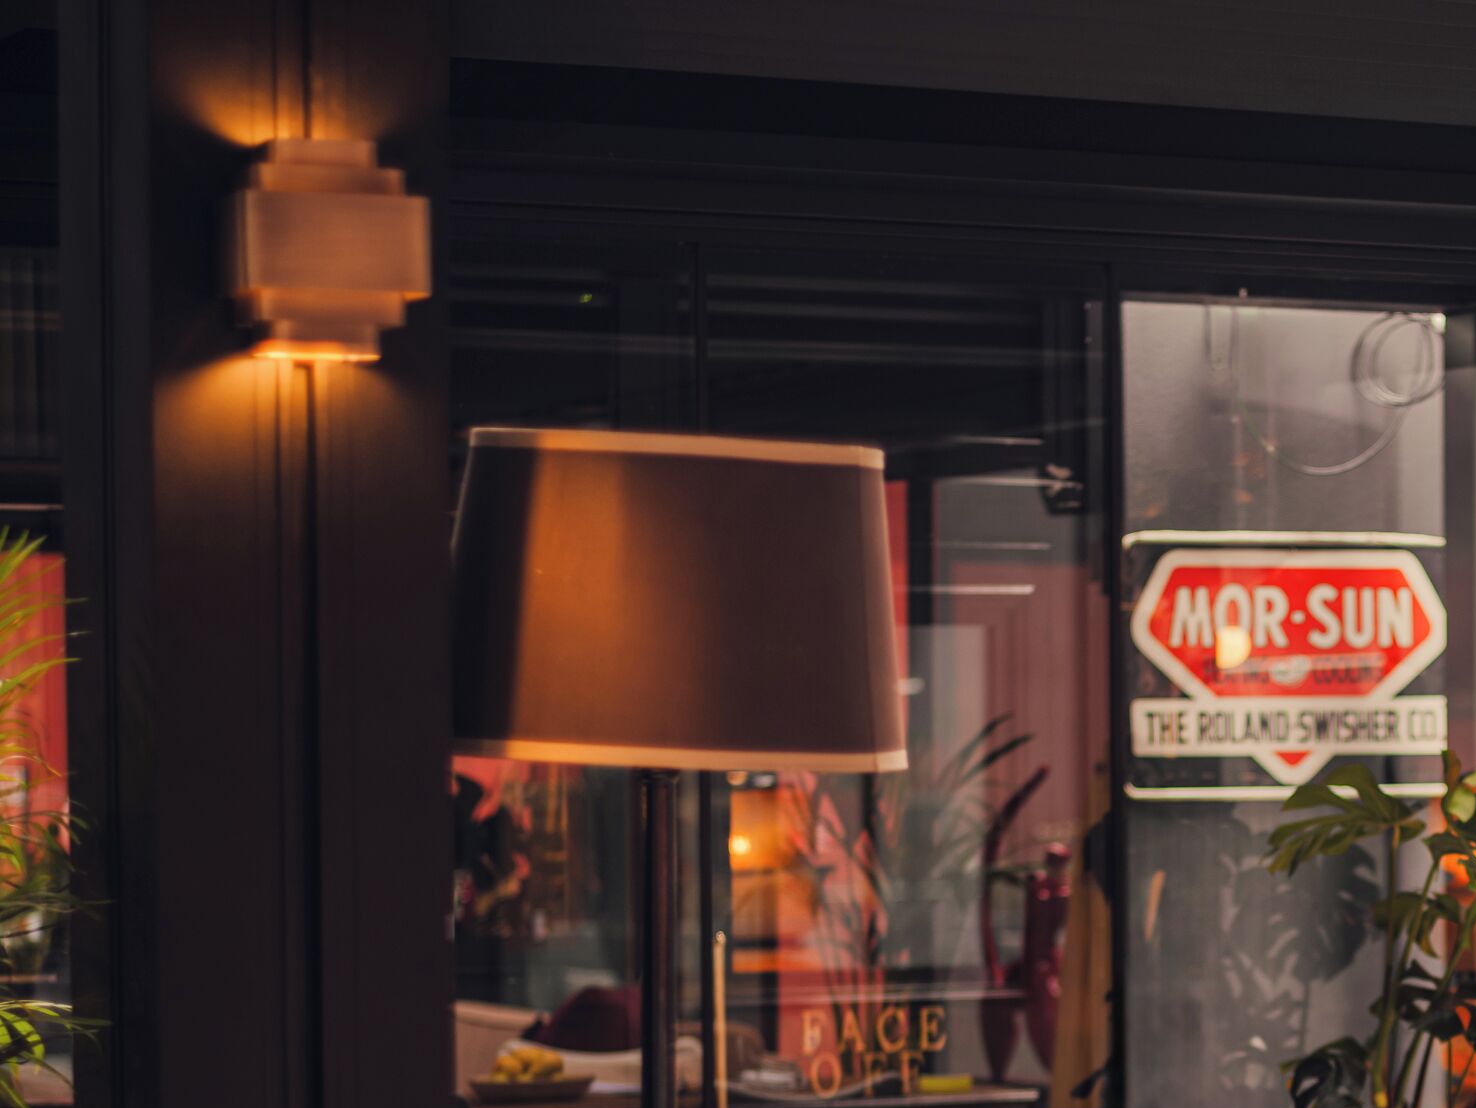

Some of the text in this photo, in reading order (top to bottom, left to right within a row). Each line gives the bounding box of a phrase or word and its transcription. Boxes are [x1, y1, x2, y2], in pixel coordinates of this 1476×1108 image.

[1145, 710, 1189, 745] THE
[802, 1006, 947, 1053] FACE
[811, 1052, 924, 1098] OFF
